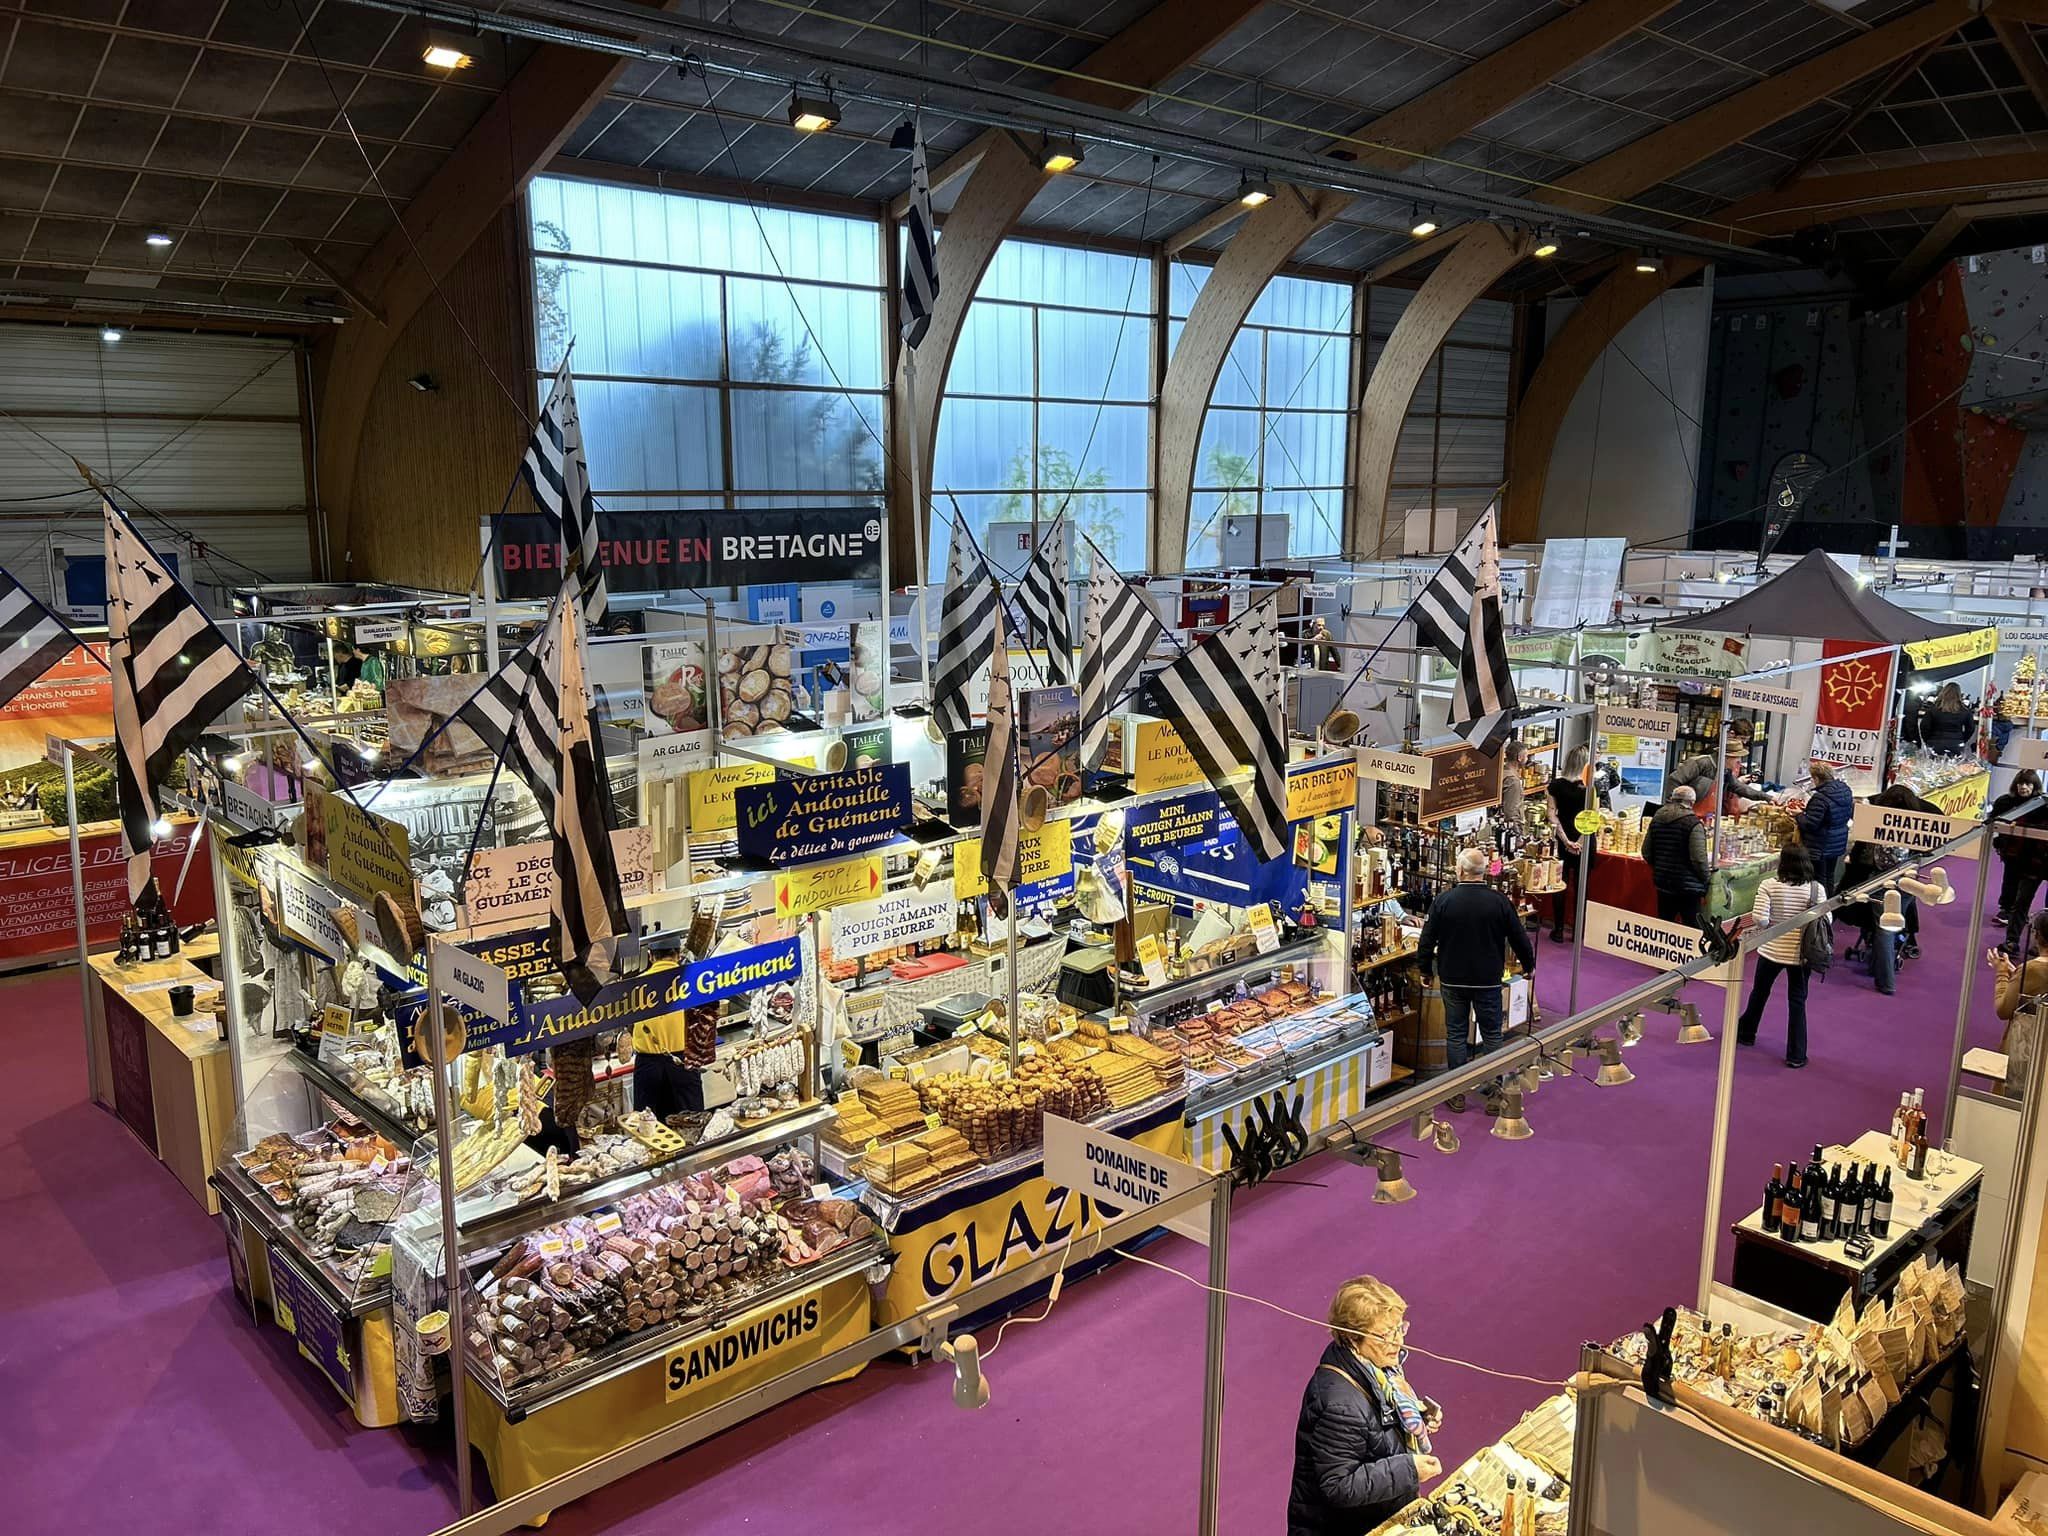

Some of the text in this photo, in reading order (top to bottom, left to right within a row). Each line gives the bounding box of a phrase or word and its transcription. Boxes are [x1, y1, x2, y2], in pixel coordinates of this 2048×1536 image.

[503, 538, 670, 570] BIEENUE
[679, 537, 712, 562] EN
[722, 532, 863, 561] BRETAGNE
[54, 687, 97, 698] NOBLES
[1752, 691, 1761, 702] DE
[21, 700, 69, 711] HONGRIE
[1605, 714, 1671, 733] COGNAC CHOLLET
[1815, 725, 1880, 740] REGION
[653, 741, 701, 758] AR GLAZIG
[851, 732, 884, 748] TALLEC
[1832, 741, 1861, 752] MIDI
[742, 766, 775, 783] Spéci
[1289, 766, 1355, 793] FAR BRETON
[1370, 759, 1416, 775] AR GLAZIG
[791, 768, 884, 796] Véritable
[746, 791, 778, 829] ici
[785, 785, 890, 819] Andouille
[1159, 803, 1186, 819] MINI
[775, 801, 902, 841] de Guémené
[1131, 816, 1174, 838] KOUIGN
[1175, 809, 1214, 828] AMANN
[1883, 813, 1950, 835] CHATEAU
[768, 829, 895, 863] Le délice du gourmet
[1139, 824, 1204, 848] PUR BEURRE
[1874, 827, 1952, 849] MAYLAND
[354, 850, 405, 888] Guémené
[516, 855, 551, 873] DÉG
[810, 865, 851, 887] STOP!
[507, 877, 530, 890] LE
[792, 879, 868, 910] ANDOUILLE
[64, 890, 118, 905] HNGRIE
[475, 886, 552, 911] GUÉMÉN
[878, 898, 911, 914] MINI
[841, 902, 948, 937] KOUIGN AMANN
[852, 918, 936, 948] PUR BEURRE
[1616, 919, 1694, 951] LA BOUTIQUE
[1607, 933, 1701, 966] DU CHAMPIGNO
[453, 967, 485, 994] AR GLAZIG
[512, 947, 797, 1047] L'Andouille de Guémené
[1085, 1142, 1169, 1190] DOMAINE DE
[1093, 1167, 1161, 1206] LA JOLIVE
[668, 1298, 819, 1392] SANDWICHS
